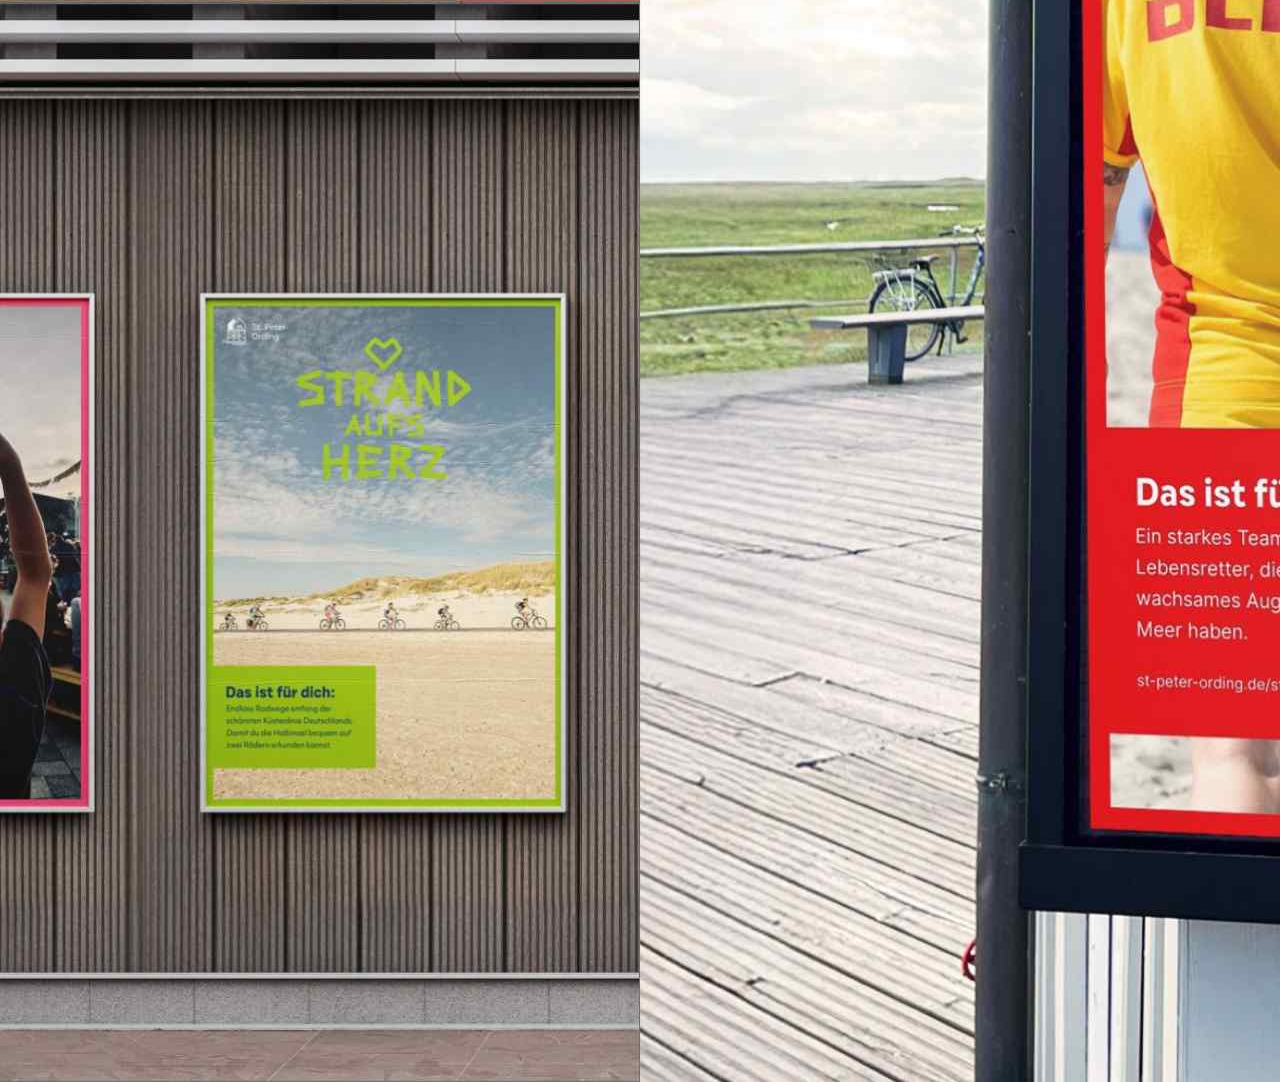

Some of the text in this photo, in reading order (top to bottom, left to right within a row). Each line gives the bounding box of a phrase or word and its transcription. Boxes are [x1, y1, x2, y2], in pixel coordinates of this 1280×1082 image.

[295, 370, 471, 407] STRAND
[344, 413, 425, 438] AUFS
[321, 443, 448, 482] HERZ
[1135, 477, 1196, 508] Das
[1204, 478, 1246, 508] ist
[1135, 527, 1162, 545] Ein
[1166, 528, 1232, 546] starkes
[1135, 558, 1254, 581] Lebensretter,
[1136, 591, 1241, 610] wachsames
[1136, 621, 1248, 641] Meer haben.
[225, 686, 335, 699] Das ist für dich:
